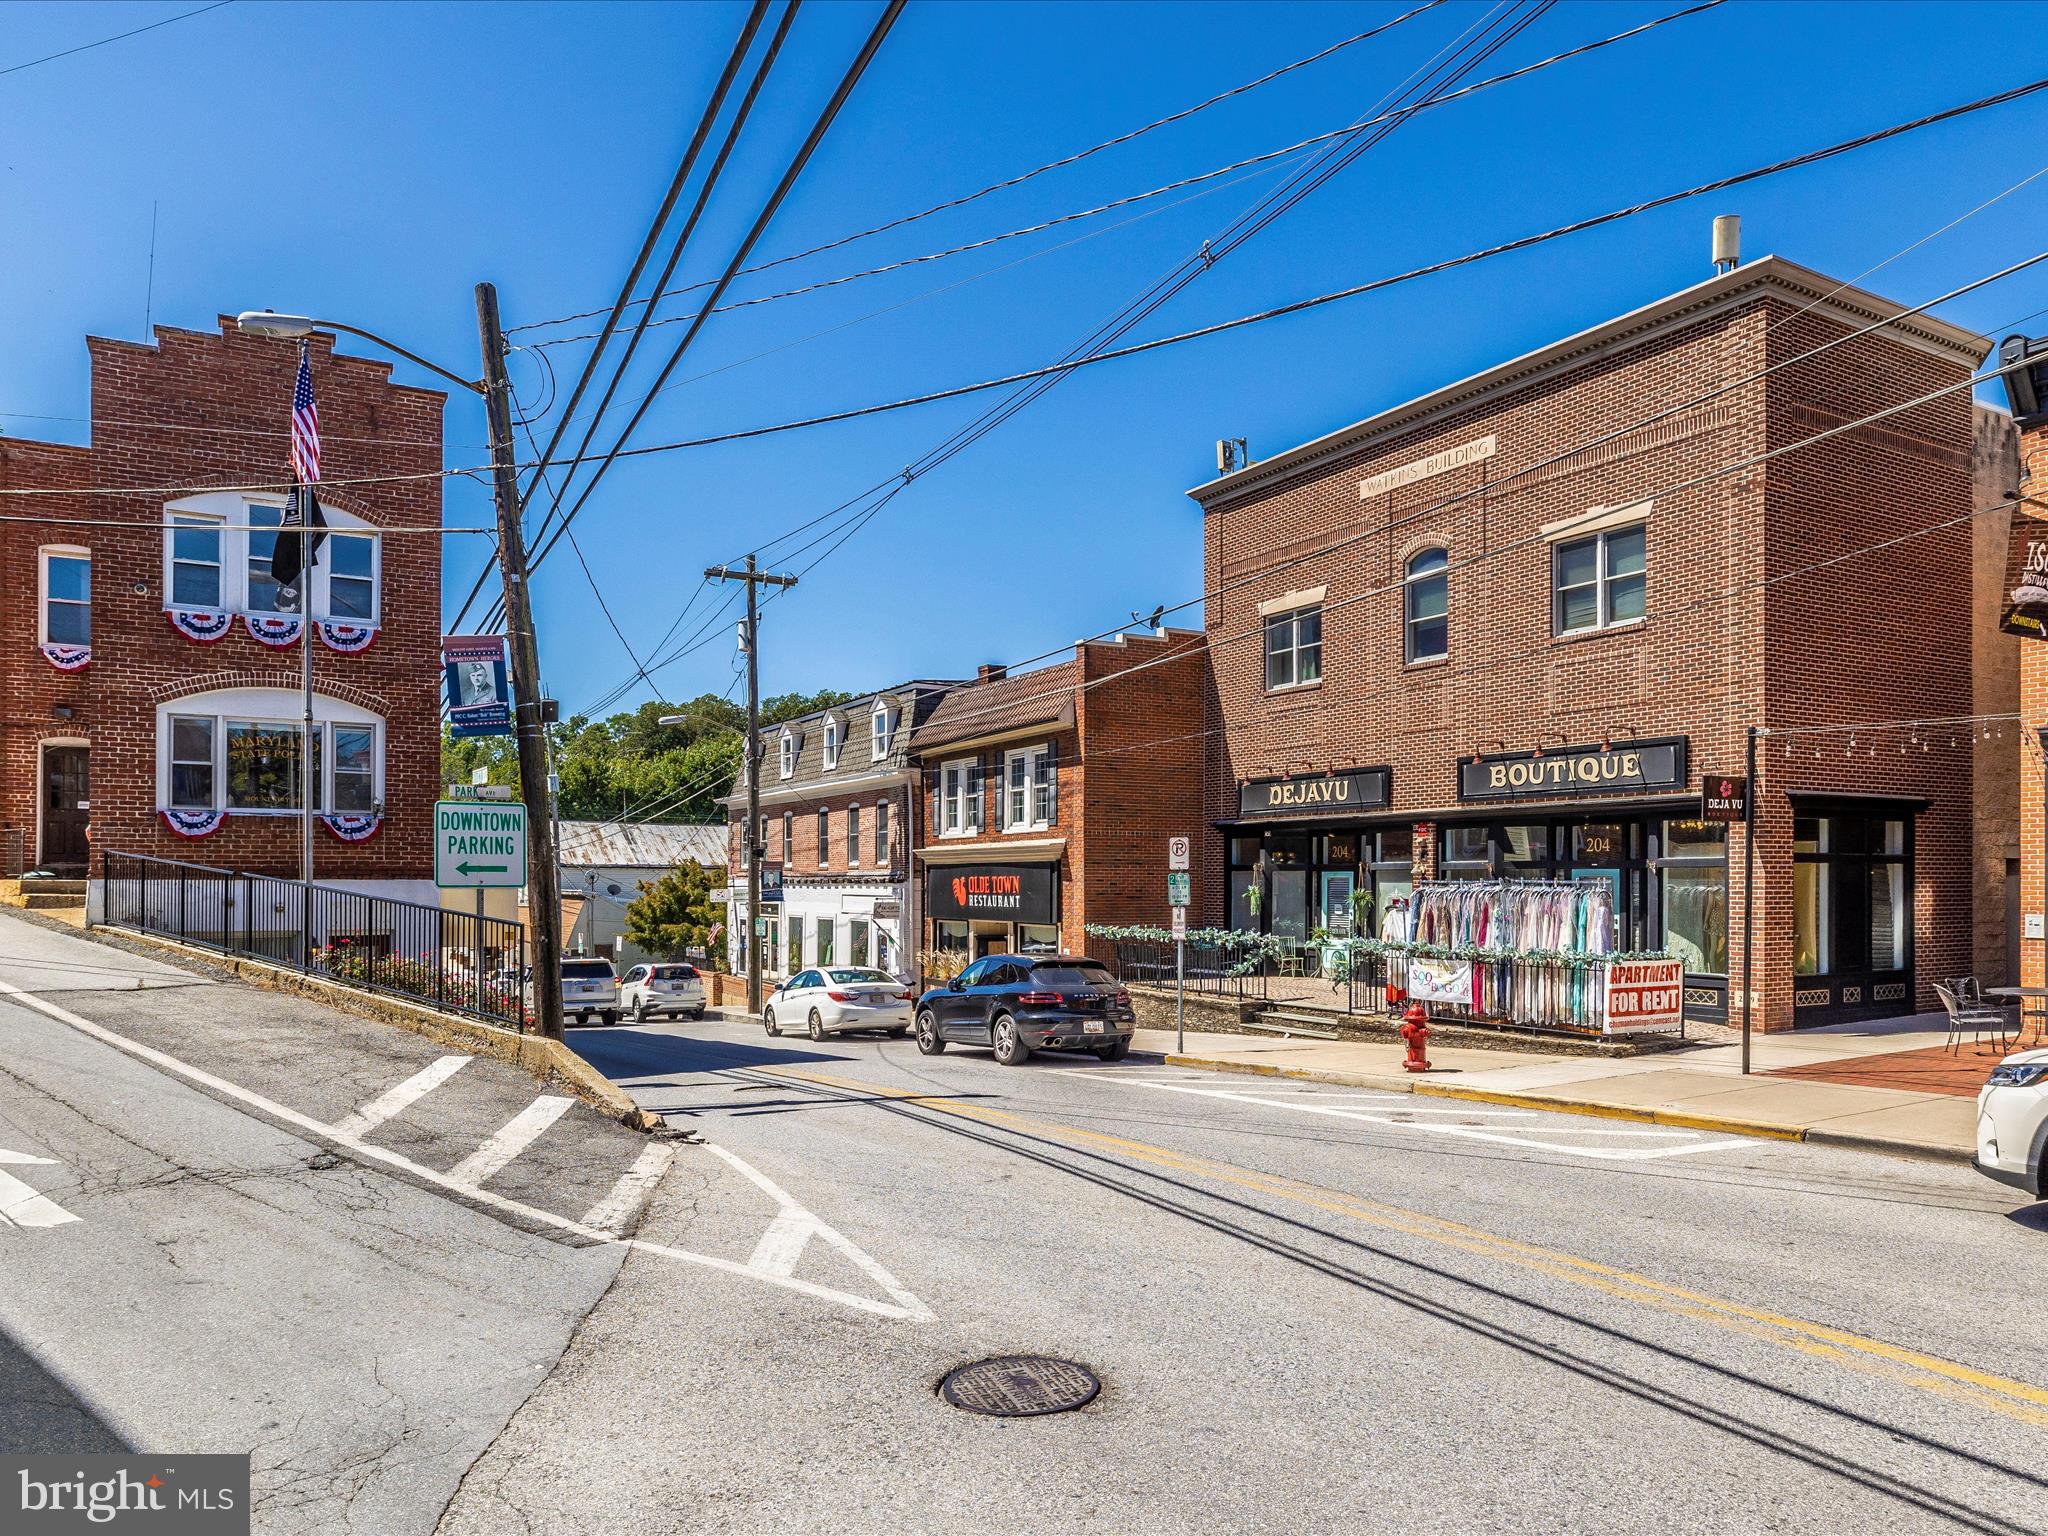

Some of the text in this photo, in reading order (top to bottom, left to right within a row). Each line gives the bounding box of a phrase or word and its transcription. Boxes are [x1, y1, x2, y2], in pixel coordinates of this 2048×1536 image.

[1366, 441, 1488, 492] WATKINS BUILDING
[2011, 614, 2040, 630] DOWNSTAIRS
[229, 748, 270, 760] STATE
[1489, 754, 1642, 788] BOUTIQUE
[455, 786, 479, 797] PARK
[1269, 780, 1349, 806] DEJAVU
[1708, 799, 1743, 810] DEJA VU
[441, 811, 521, 832] DOWNTOWN
[448, 835, 514, 855] PARKING
[1331, 845, 1349, 859] 204
[1586, 837, 1611, 852] 204
[968, 875, 1020, 894] OLDE TOWN
[968, 894, 1021, 908] RESTAURANT
[1609, 963, 1681, 985] APARTMENT
[1611, 989, 1679, 1013] FOR RENT
